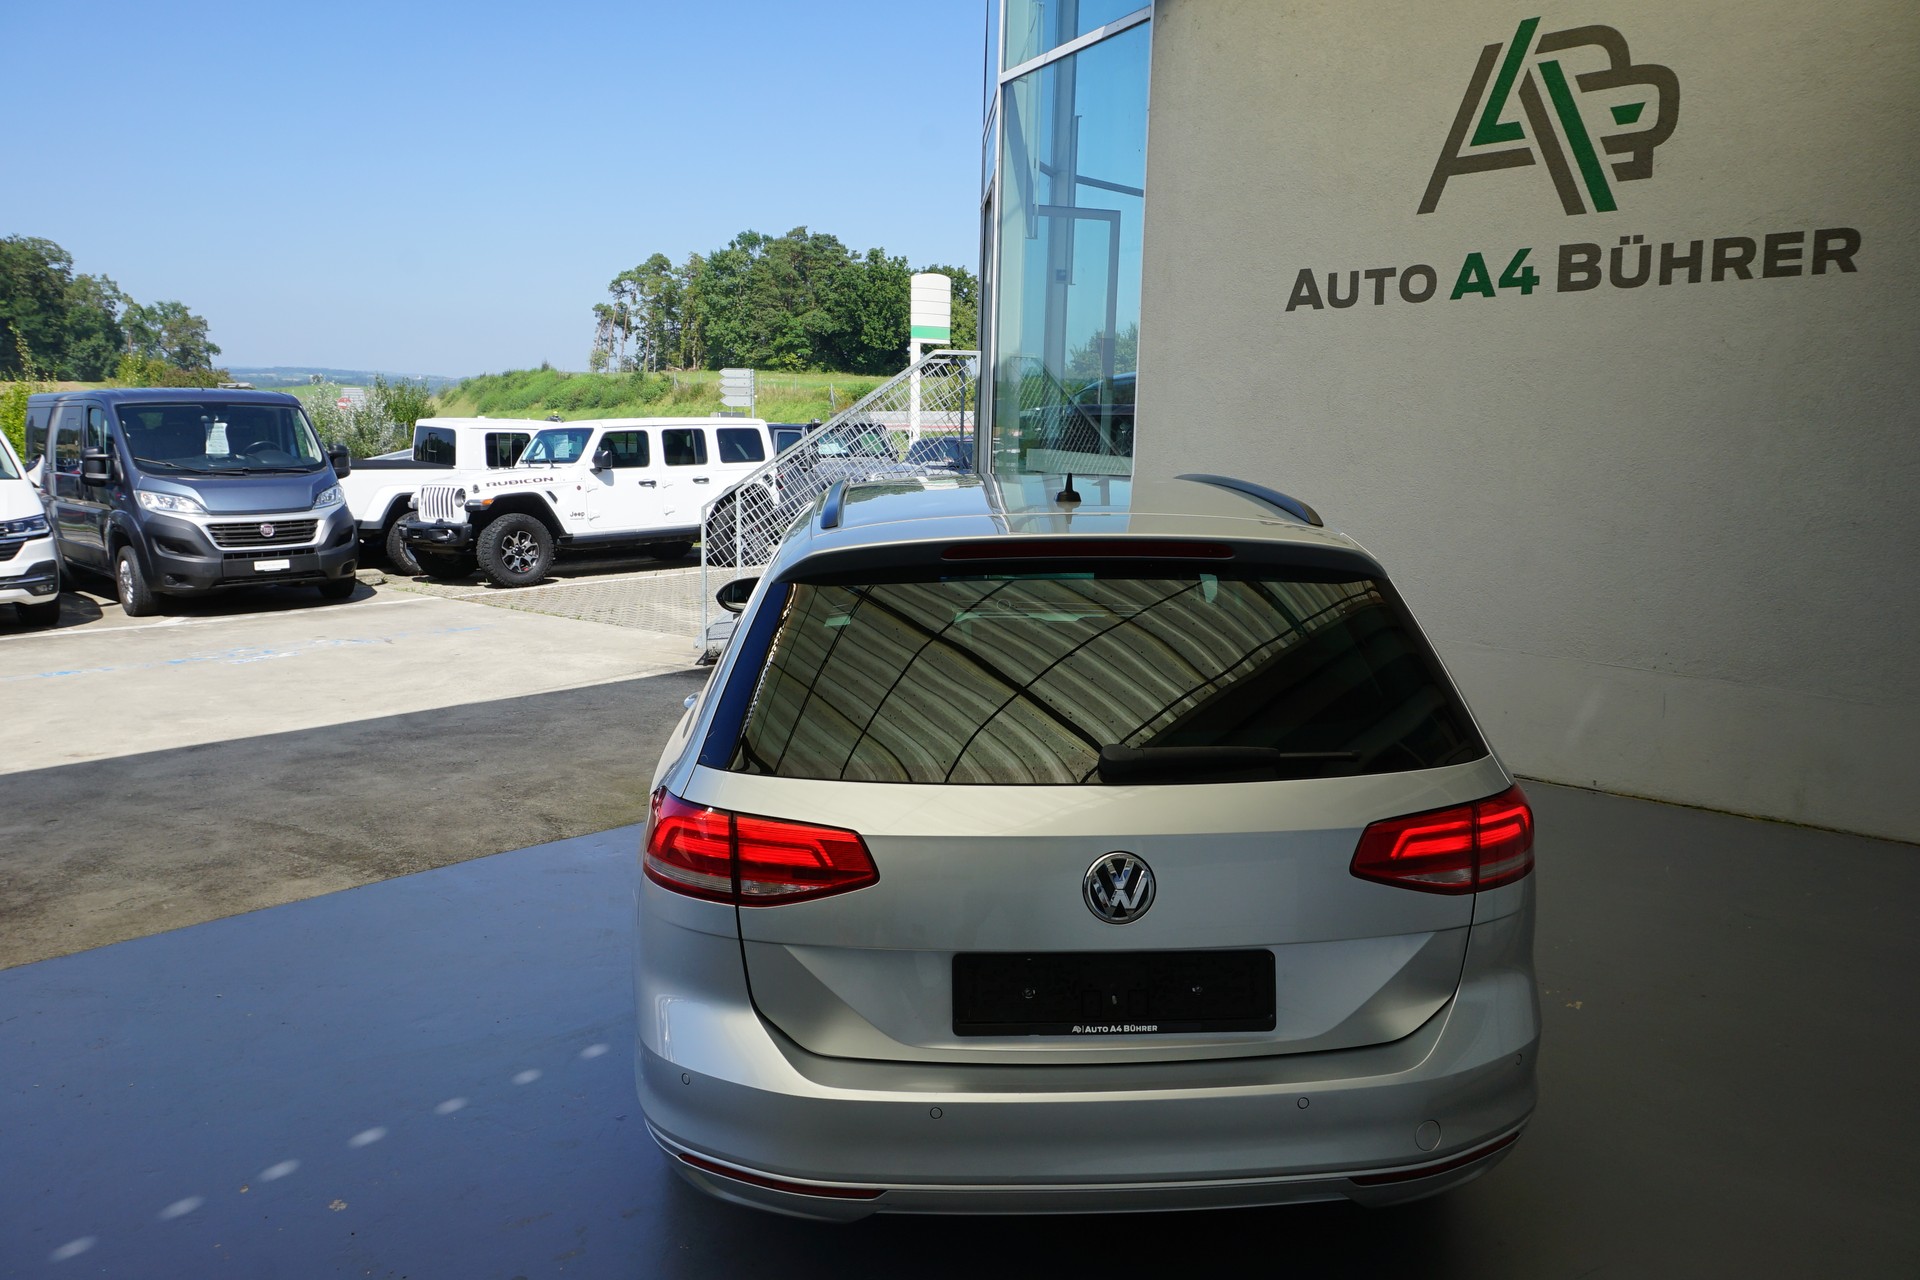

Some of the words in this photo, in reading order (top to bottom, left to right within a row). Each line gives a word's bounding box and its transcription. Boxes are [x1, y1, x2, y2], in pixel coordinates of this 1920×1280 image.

[1285, 264, 1438, 312] AUTO
[1450, 248, 1540, 300] A4
[1557, 227, 1862, 293] BÜHRER
[486, 477, 554, 487] RUBICON
[1085, 1025, 1109, 1034] AUTO
[1109, 1025, 1122, 1033] A4
[1123, 1024, 1158, 1032] BÜHRER
